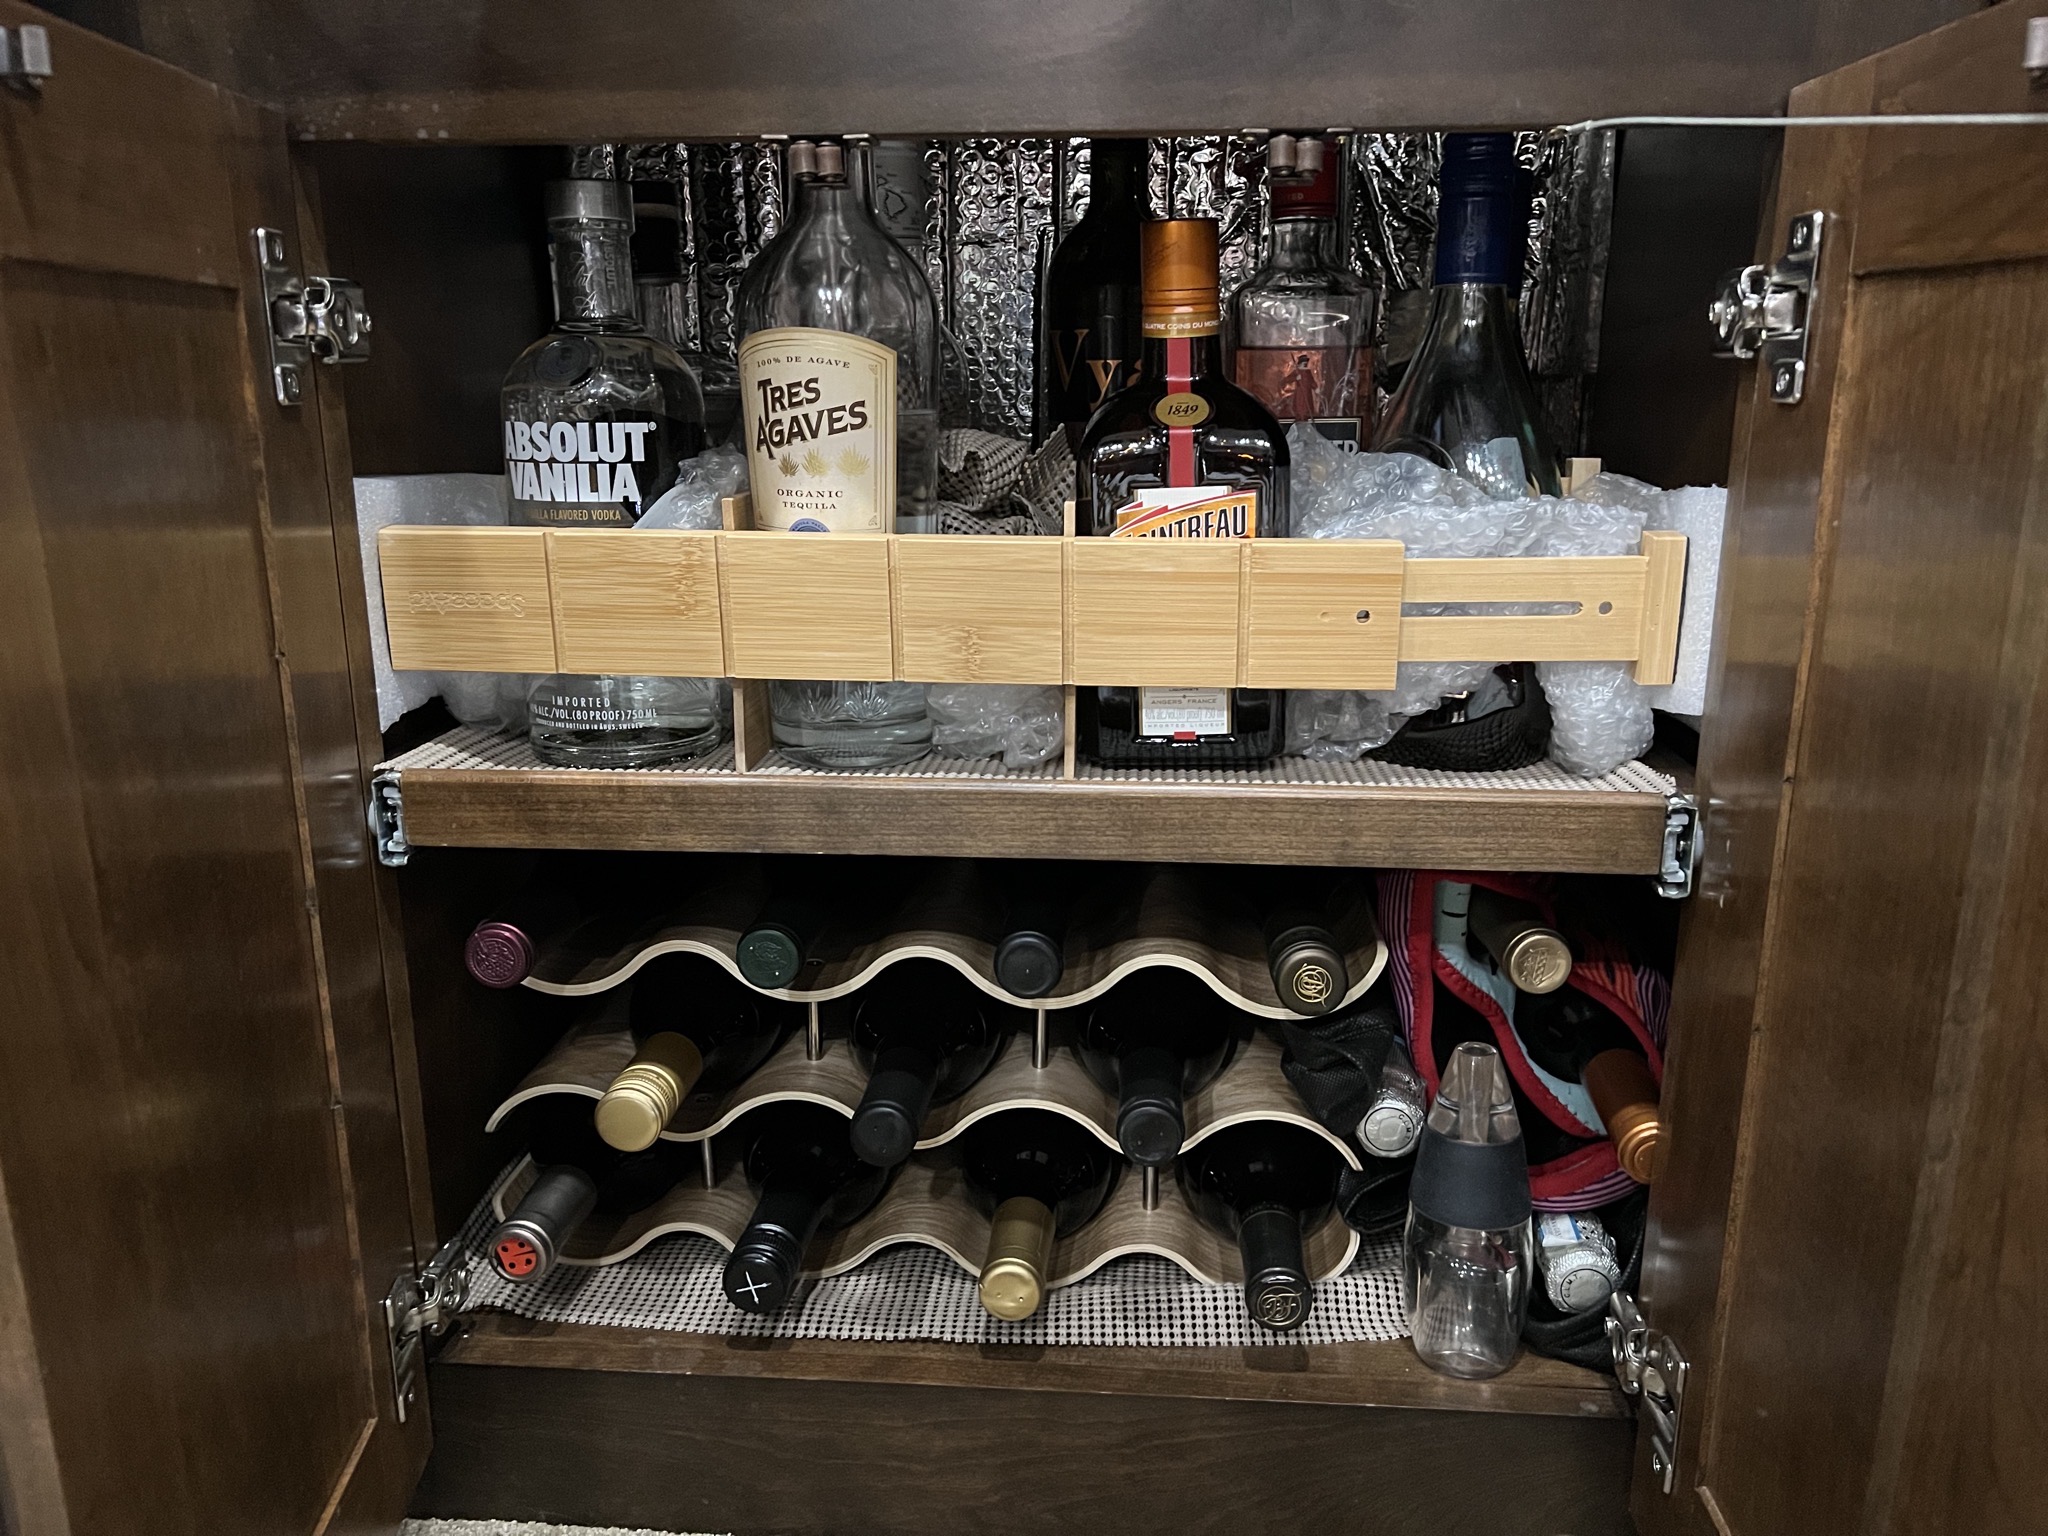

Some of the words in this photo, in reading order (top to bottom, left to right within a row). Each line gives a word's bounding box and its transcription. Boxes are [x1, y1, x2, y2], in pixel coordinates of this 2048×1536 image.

[1192, 321, 1203, 329] DU
[757, 357, 781, 368] 100%
[786, 355, 802, 363] DE
[807, 357, 851, 369] AGAVE
[757, 377, 821, 427] TRES
[1167, 402, 1199, 417] 1849
[756, 400, 868, 460] AGAVES
[509, 462, 642, 503] VANILIA
[777, 488, 843, 498] ORGANIC
[782, 501, 837, 510] TEQUILA
[550, 509, 588, 521] FLAVORED
[591, 509, 621, 521] VODKA
[552, 695, 611, 708] IMPORTED
[566, 722, 590, 730] BOTTLED
